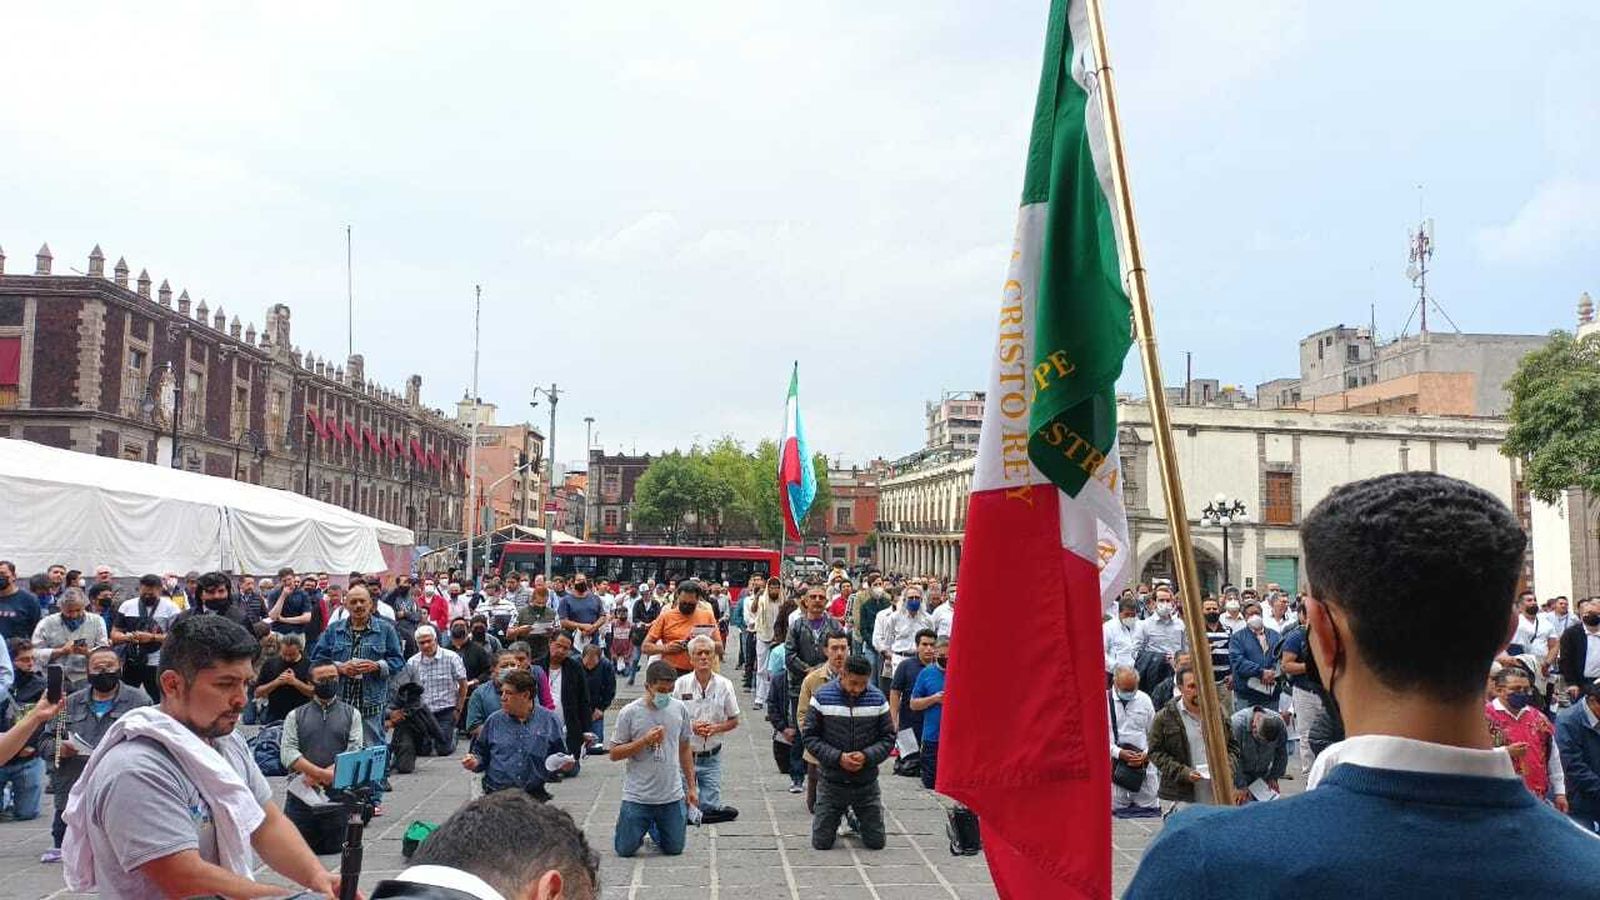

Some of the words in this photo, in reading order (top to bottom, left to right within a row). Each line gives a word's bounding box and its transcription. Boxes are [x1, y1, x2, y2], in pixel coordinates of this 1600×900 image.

[1000, 280, 1027, 418] CRISTO
[1031, 350, 1076, 402] PE
[1002, 430, 1034, 507] REY
